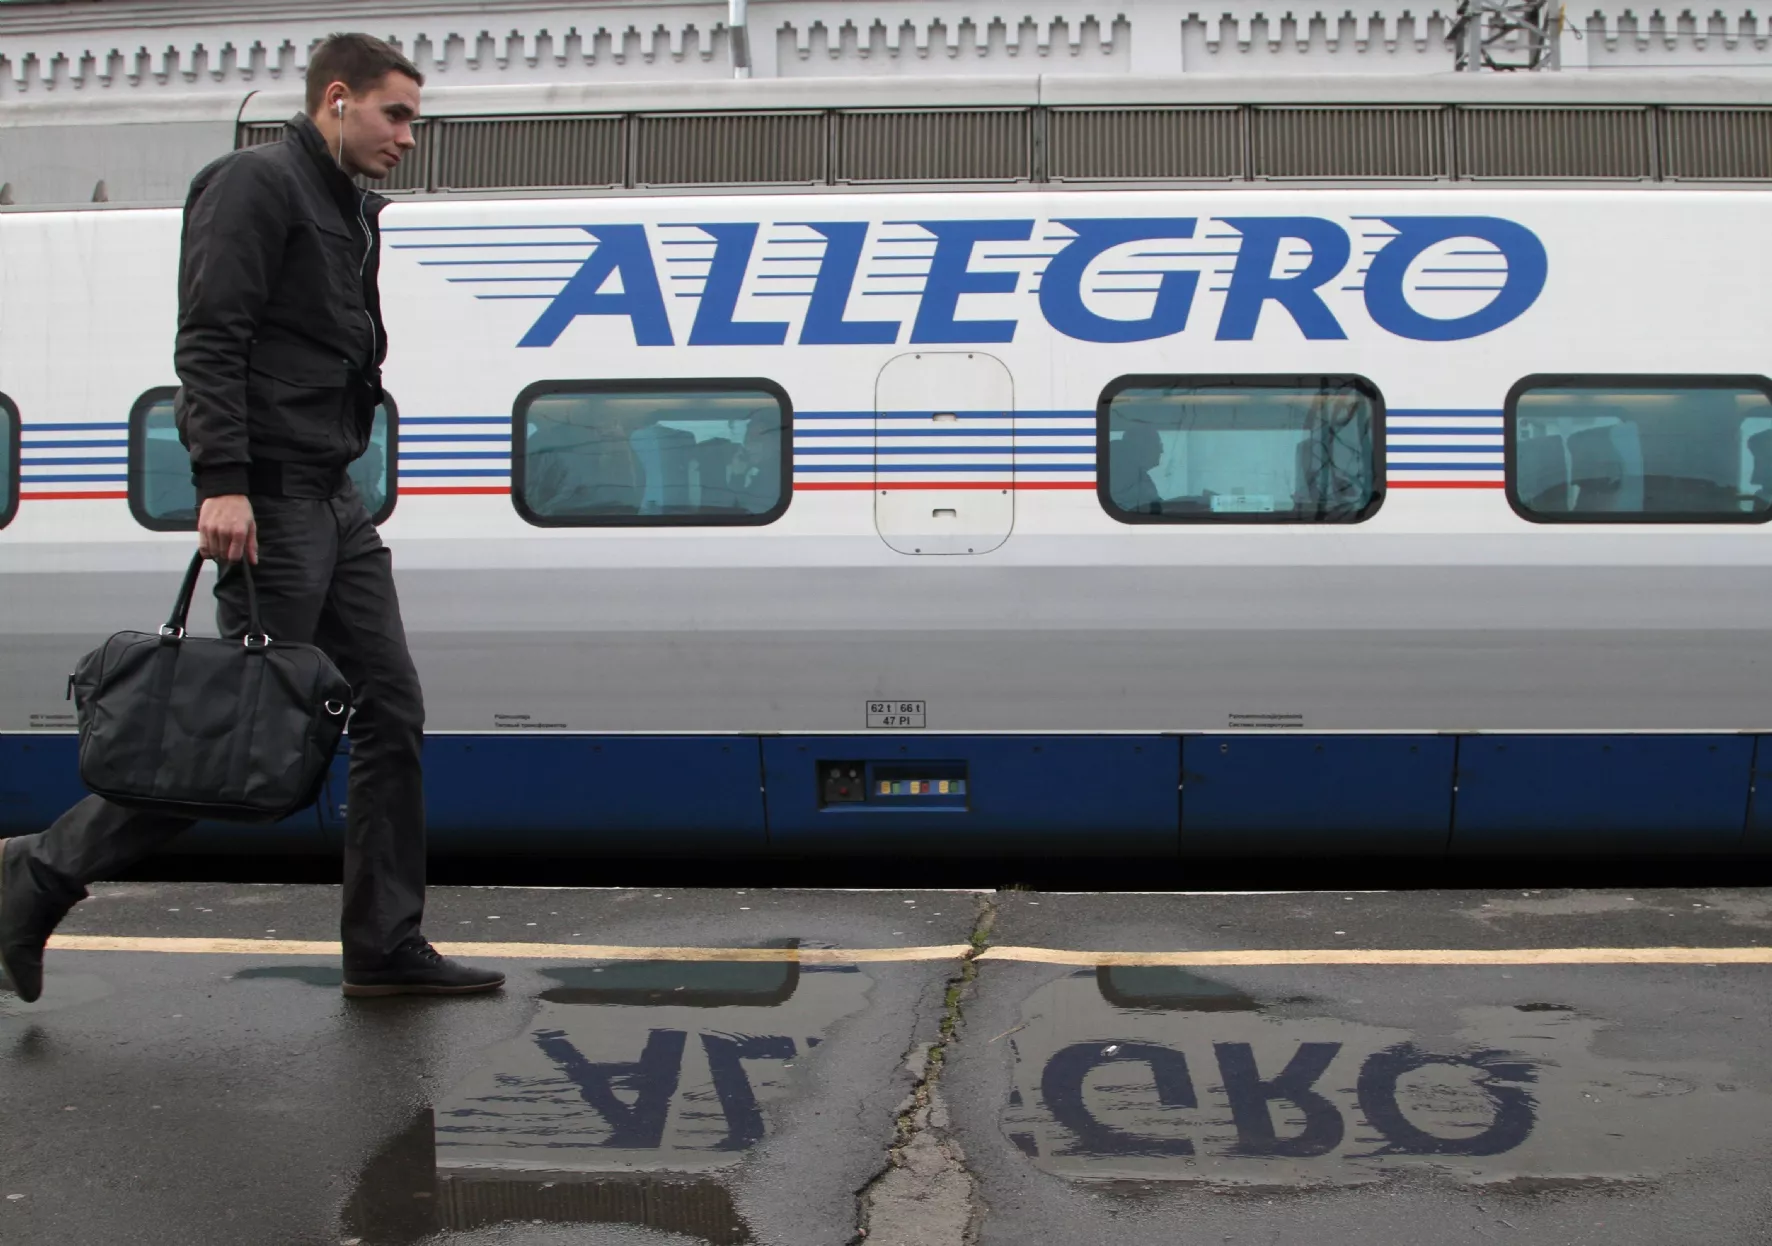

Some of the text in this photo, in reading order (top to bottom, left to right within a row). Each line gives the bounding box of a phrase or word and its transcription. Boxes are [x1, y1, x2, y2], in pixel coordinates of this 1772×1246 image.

[516, 215, 1548, 347] ALLEGRO
[871, 703, 891, 713] 62 t
[900, 703, 920, 713] 66 t
[883, 716, 896, 725] 47
